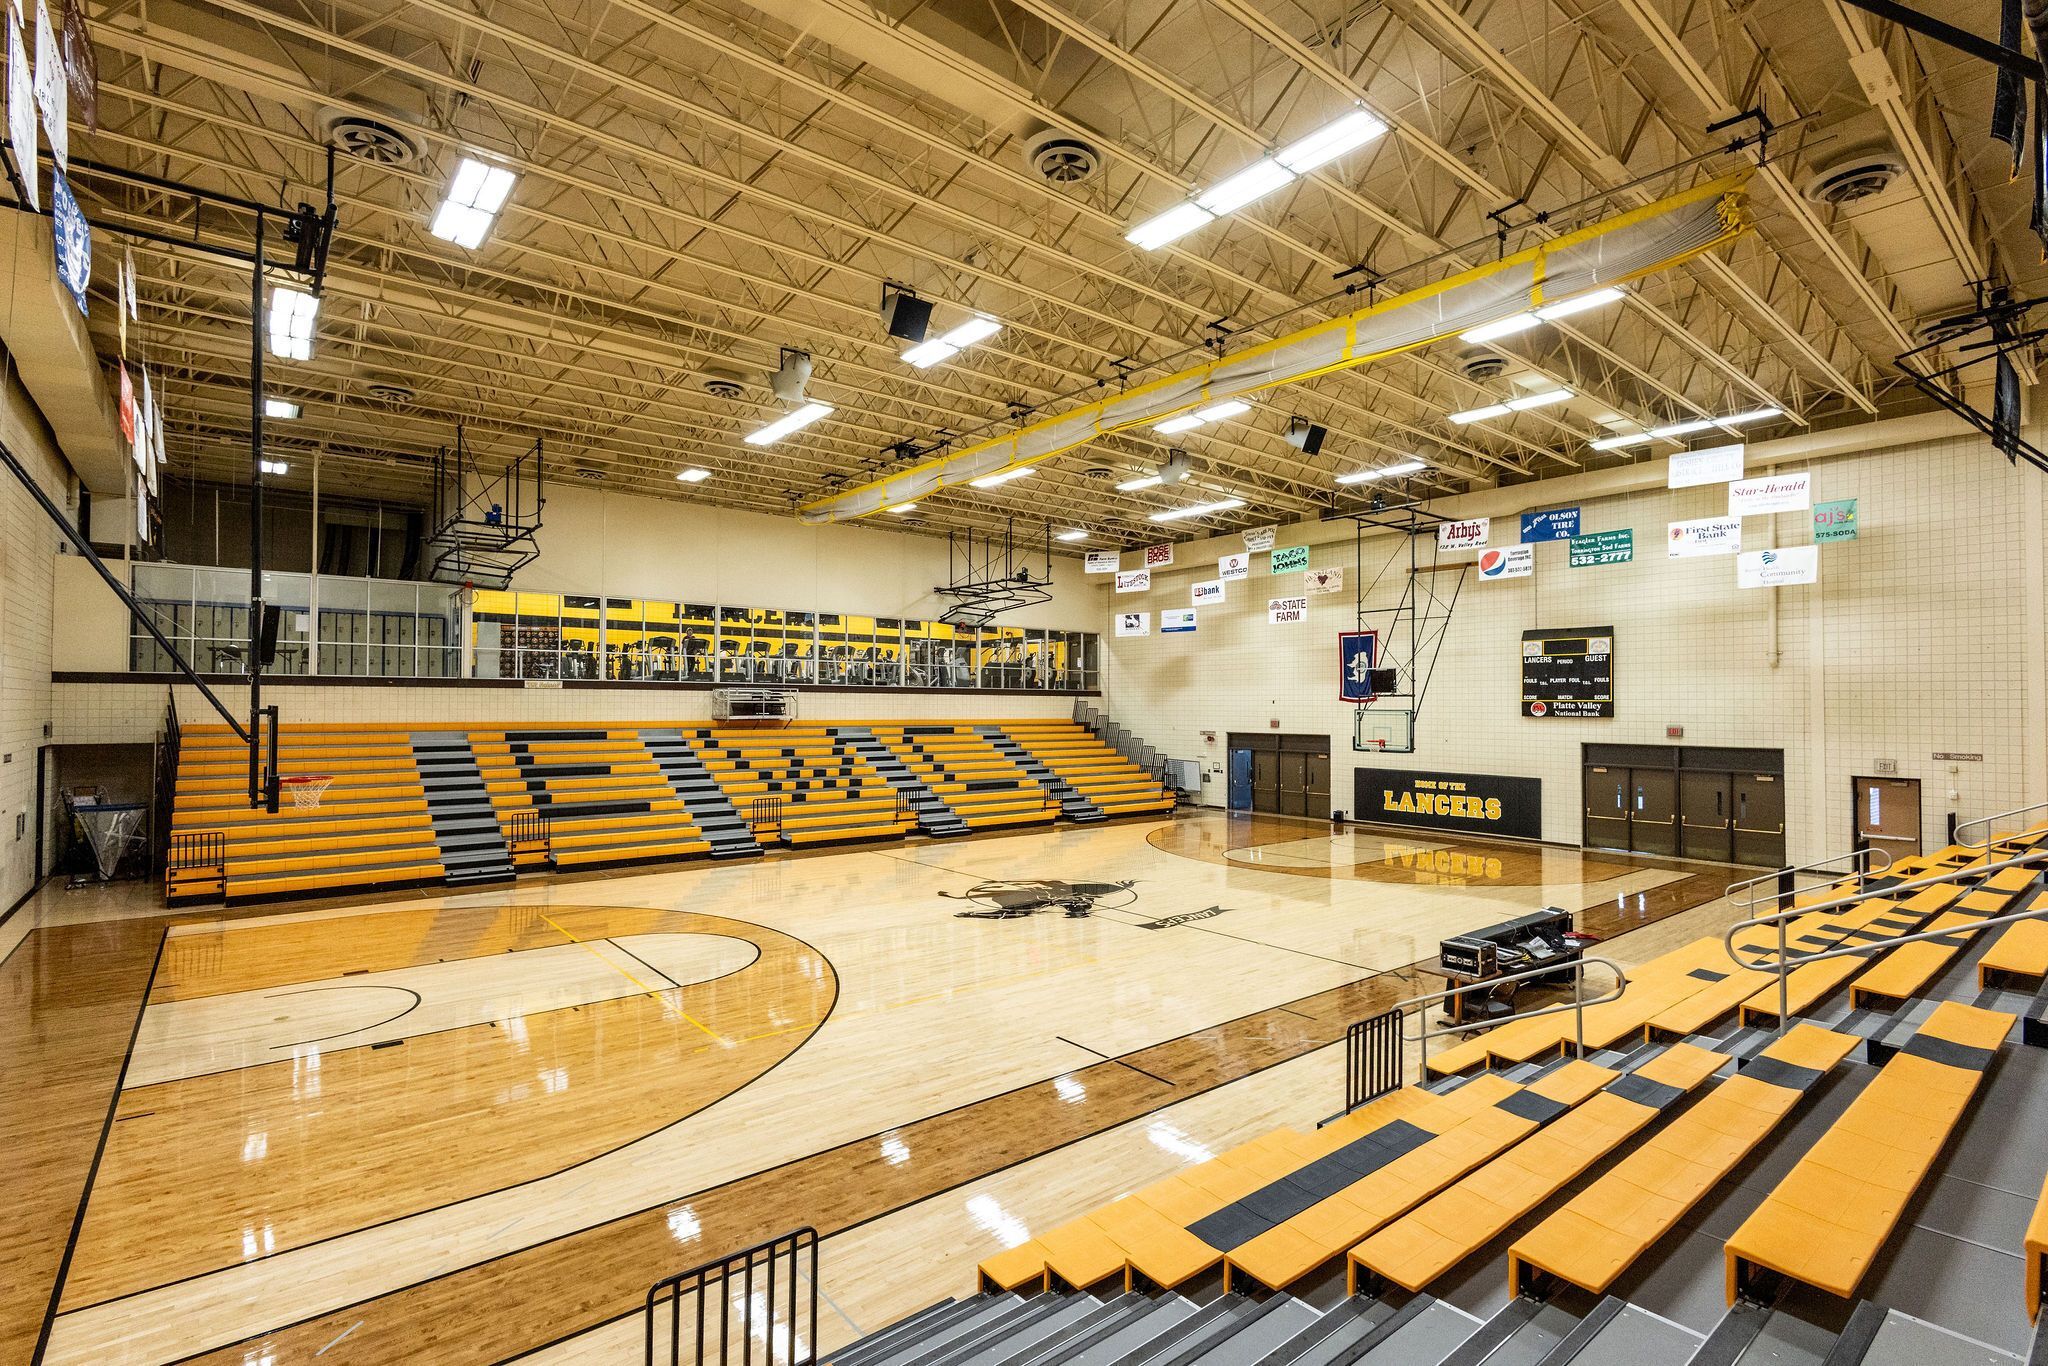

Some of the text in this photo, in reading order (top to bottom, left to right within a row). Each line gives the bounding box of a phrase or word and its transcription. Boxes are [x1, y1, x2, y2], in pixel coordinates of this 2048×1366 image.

[1733, 480, 1806, 497] Star-Herald
[1549, 510, 1578, 520] OLSON
[1552, 520, 1575, 530] TIRE
[1686, 523, 1740, 534] First State
[1447, 521, 1481, 541] Arby's
[1556, 530, 1570, 538] CO.
[1699, 530, 1727, 539] Bank
[1816, 529, 1856, 538] 575-SODA
[1148, 545, 1169, 555] ROSE
[1273, 547, 1305, 562] TACO
[1571, 551, 1631, 565] 532-2777
[1760, 568, 1806, 578] Community
[1282, 599, 1306, 610] STATE
[1276, 611, 1300, 622] FARM
[1524, 656, 1552, 664] LANCERS
[1578, 702, 1602, 711] Valley
[1950, 753, 1982, 761] Smoking
[1415, 780, 1466, 791] HOME OF THE
[1383, 790, 1502, 820] LANCERS
